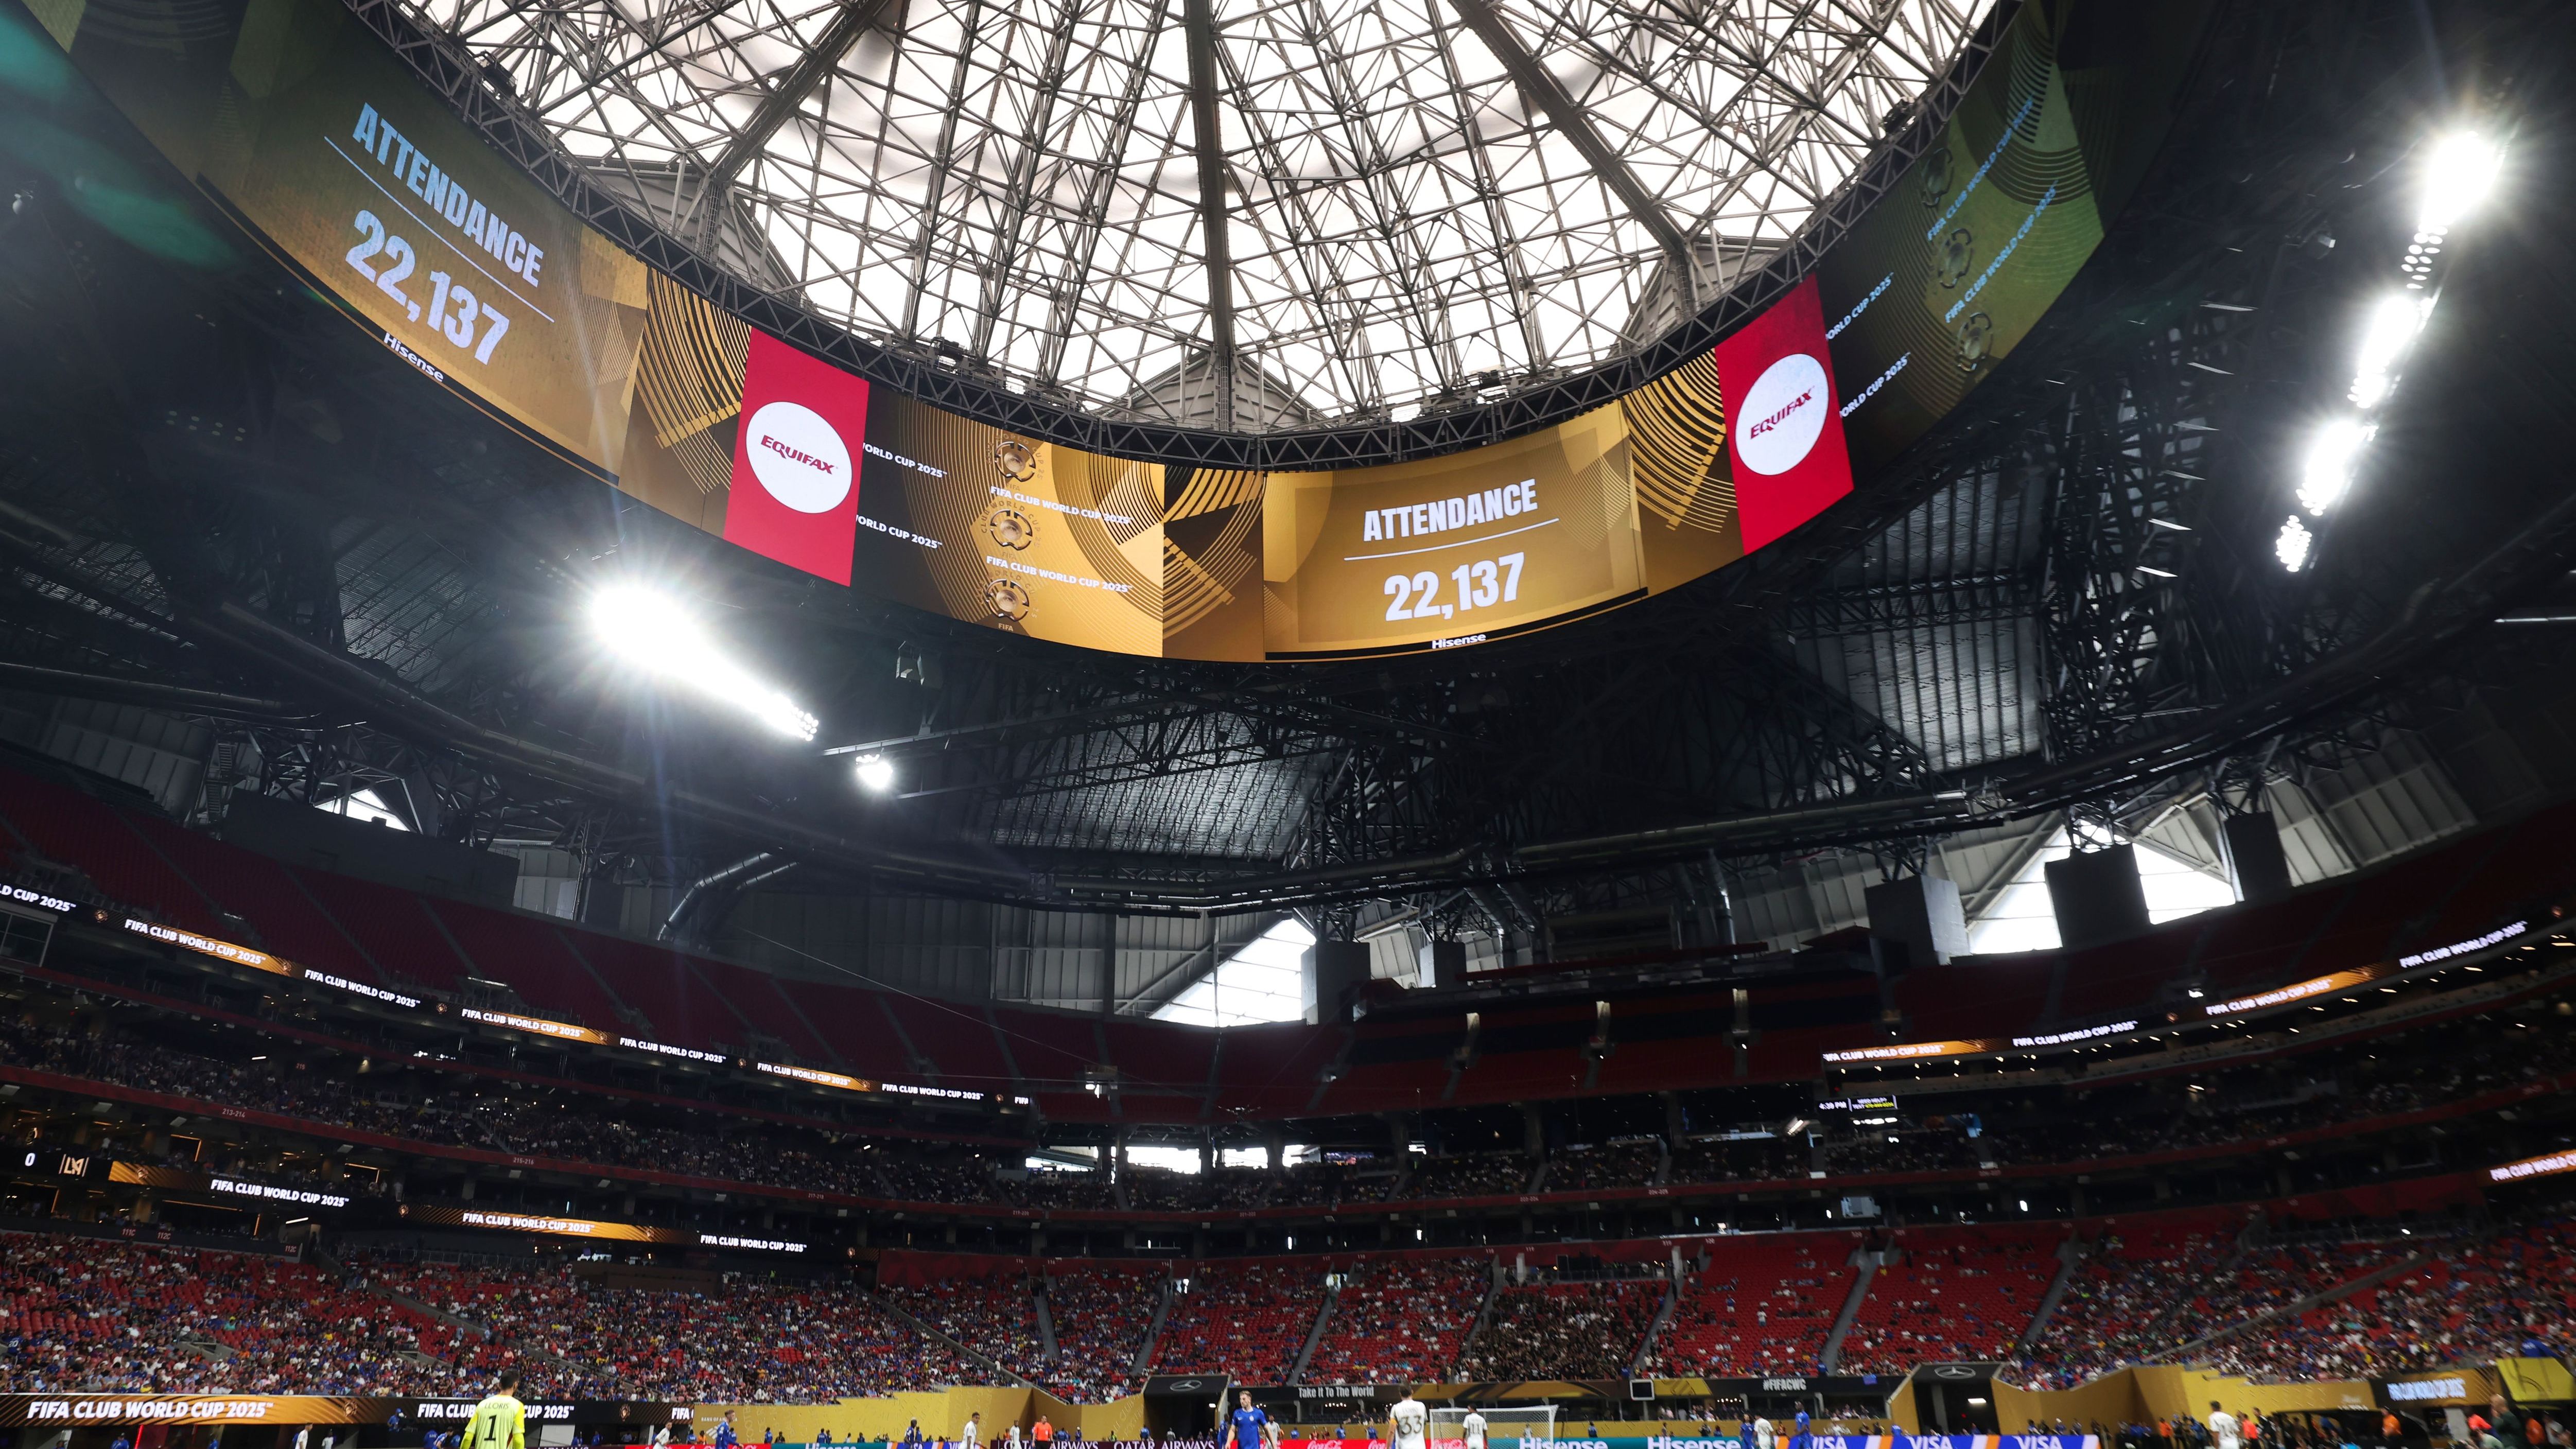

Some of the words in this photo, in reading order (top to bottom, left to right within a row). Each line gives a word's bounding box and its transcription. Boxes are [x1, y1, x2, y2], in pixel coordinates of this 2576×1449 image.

[353, 102, 544, 287] ATTENDANCE
[345, 210, 510, 365] 22,137
[1825, 315, 1851, 340] ORLD
[1851, 298, 1869, 318] CUP
[384, 332, 444, 382] Hisense
[1839, 393, 1866, 418] ORLD
[1866, 376, 1884, 396] CUP
[1750, 387, 1813, 439] EQUIFAX
[761, 434, 835, 474] EQUIFAX
[895, 455, 915, 468] CUP
[990, 485, 1012, 499] FIFA
[1014, 493, 1040, 506] CLUB
[1042, 500, 1080, 515] WORLD
[1081, 509, 1102, 519] CUP
[1363, 479, 1538, 542] ATTENDANCE
[889, 527, 910, 539] CUP
[987, 555, 1008, 569] FIFA
[1010, 562, 1037, 575] CLUB
[1039, 569, 1077, 584] WORLD
[1078, 578, 1100, 588] CUP
[1384, 552, 1524, 621] 22,137
[999, 623, 1014, 632] FIFA
[1432, 633, 1486, 649] Hisense
[13, 889, 39, 902] CUP
[125, 919, 148, 934] FIFA
[150, 927, 178, 941] CLUB
[179, 933, 216, 951] WORLD
[216, 945, 237, 956] CUP
[304, 969, 323, 983] FIFA
[325, 975, 347, 988] CLUB
[348, 982, 378, 997] WORLD
[378, 990, 395, 1002] CUP
[461, 1008, 482, 1020] FIFA
[483, 1012, 506, 1024] CLUB
[508, 1017, 539, 1030] WORLD
[541, 1023, 559, 1034] CUP
[620, 1037, 637, 1048] FIFA
[638, 1041, 658, 1051] CLUB
[659, 1044, 687, 1057] WORLD
[688, 1050, 704, 1059] CUP
[757, 1062, 773, 1073] FIFA
[773, 1066, 791, 1075] CLUB
[792, 1069, 816, 1080] WORLD
[817, 1074, 831, 1083] CUP
[882, 1084, 898, 1092] FIFA
[899, 1085, 918, 1094] CLUB
[919, 1087, 946, 1097] WORLD
[947, 1090, 962, 1098] CUP
[222, 1108, 246, 1118] 213-214
[25, 1153, 36, 1166] 0
[211, 1179, 233, 1192] FIFA
[235, 1183, 262, 1196] CLUB
[264, 1186, 300, 1201] WORLD
[301, 1192, 320, 1203] CUP
[462, 1213, 483, 1224] FIFA
[485, 1215, 511, 1226] CLUB
[512, 1217, 547, 1229] WORLD
[548, 1221, 567, 1231] CUP
[157, 1232, 171, 1240] 112C
[700, 1235, 718, 1245] FIFA
[719, 1236, 739, 1246] CLUB
[740, 1238, 768, 1249] WORLD
[769, 1241, 785, 1251] CUP
[1298, 1387, 1316, 1399] Take
[1318, 1386, 1324, 1398] It
[1326, 1386, 1334, 1398] To
[1336, 1386, 1350, 1397] The
[1351, 1385, 1374, 1397] World
[27, 1401, 69, 1419] FIFA
[73, 1401, 122, 1419] CLUB
[125, 1401, 188, 1418] WORLD
[191, 1402, 224, 1418] CUP
[417, 1403, 441, 1418] FIFA
[446, 1404, 476, 1418] CLUB
[671, 1407, 690, 1420] FIFA
[484, 1415, 497, 1441] 1
[1400, 1416, 1422, 1435] 33
[1113, 1441, 1155, 1449] QATAR
[1161, 1441, 1215, 1449] AIRWAYS
[1520, 1437, 1608, 1449] Hisense
[1647, 1436, 1741, 1449] Hisense
[1906, 1436, 1953, 1449] VISA
[2013, 1435, 2063, 1449] VISA
